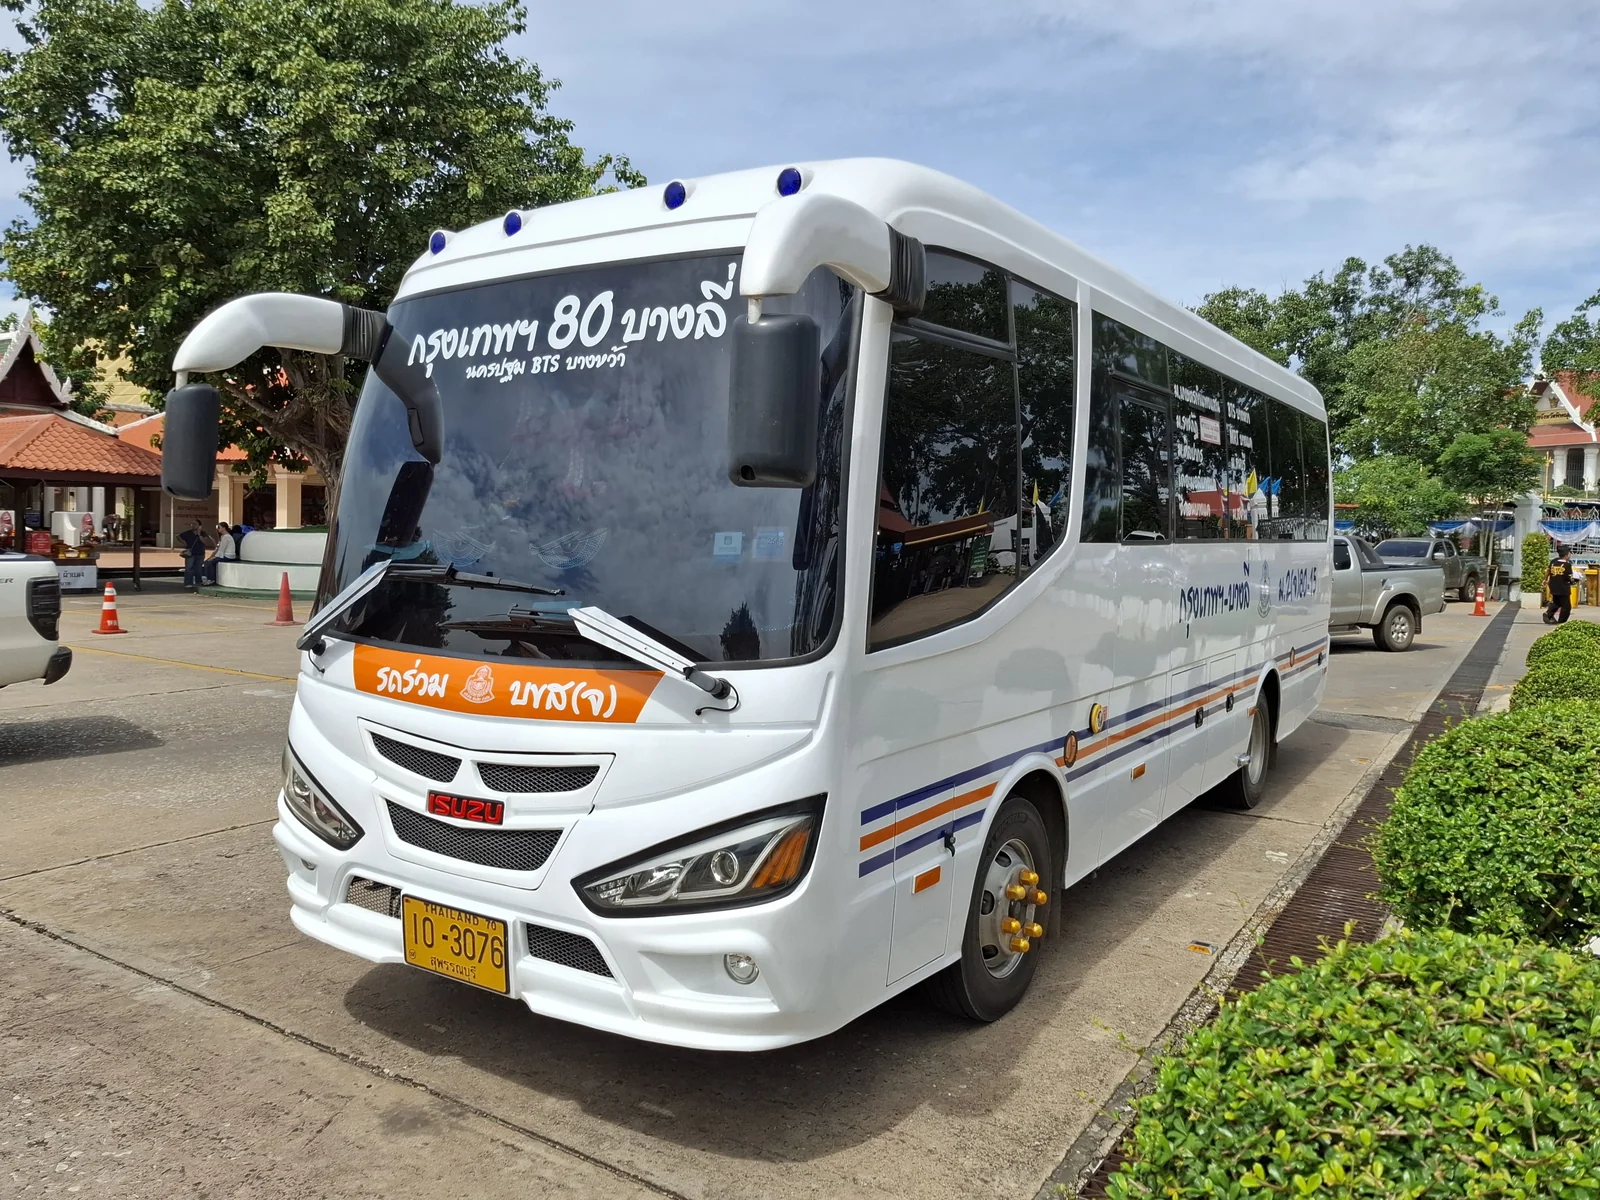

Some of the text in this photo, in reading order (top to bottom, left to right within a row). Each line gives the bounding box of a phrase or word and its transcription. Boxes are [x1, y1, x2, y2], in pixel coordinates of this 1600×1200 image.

[408, 262, 737, 378] กรุงเทพฯ 80 บางลี่
[466, 345, 628, 383] นครปฐม BTS บางหว้า
[376, 659, 450, 698] รถร่วม
[428, 793, 503, 824] ISUZU
[423, 902, 497, 931] THAILAND 70
[413, 912, 504, 970] 10-3076
[430, 957, 477, 982] สุพรรณบุรี
